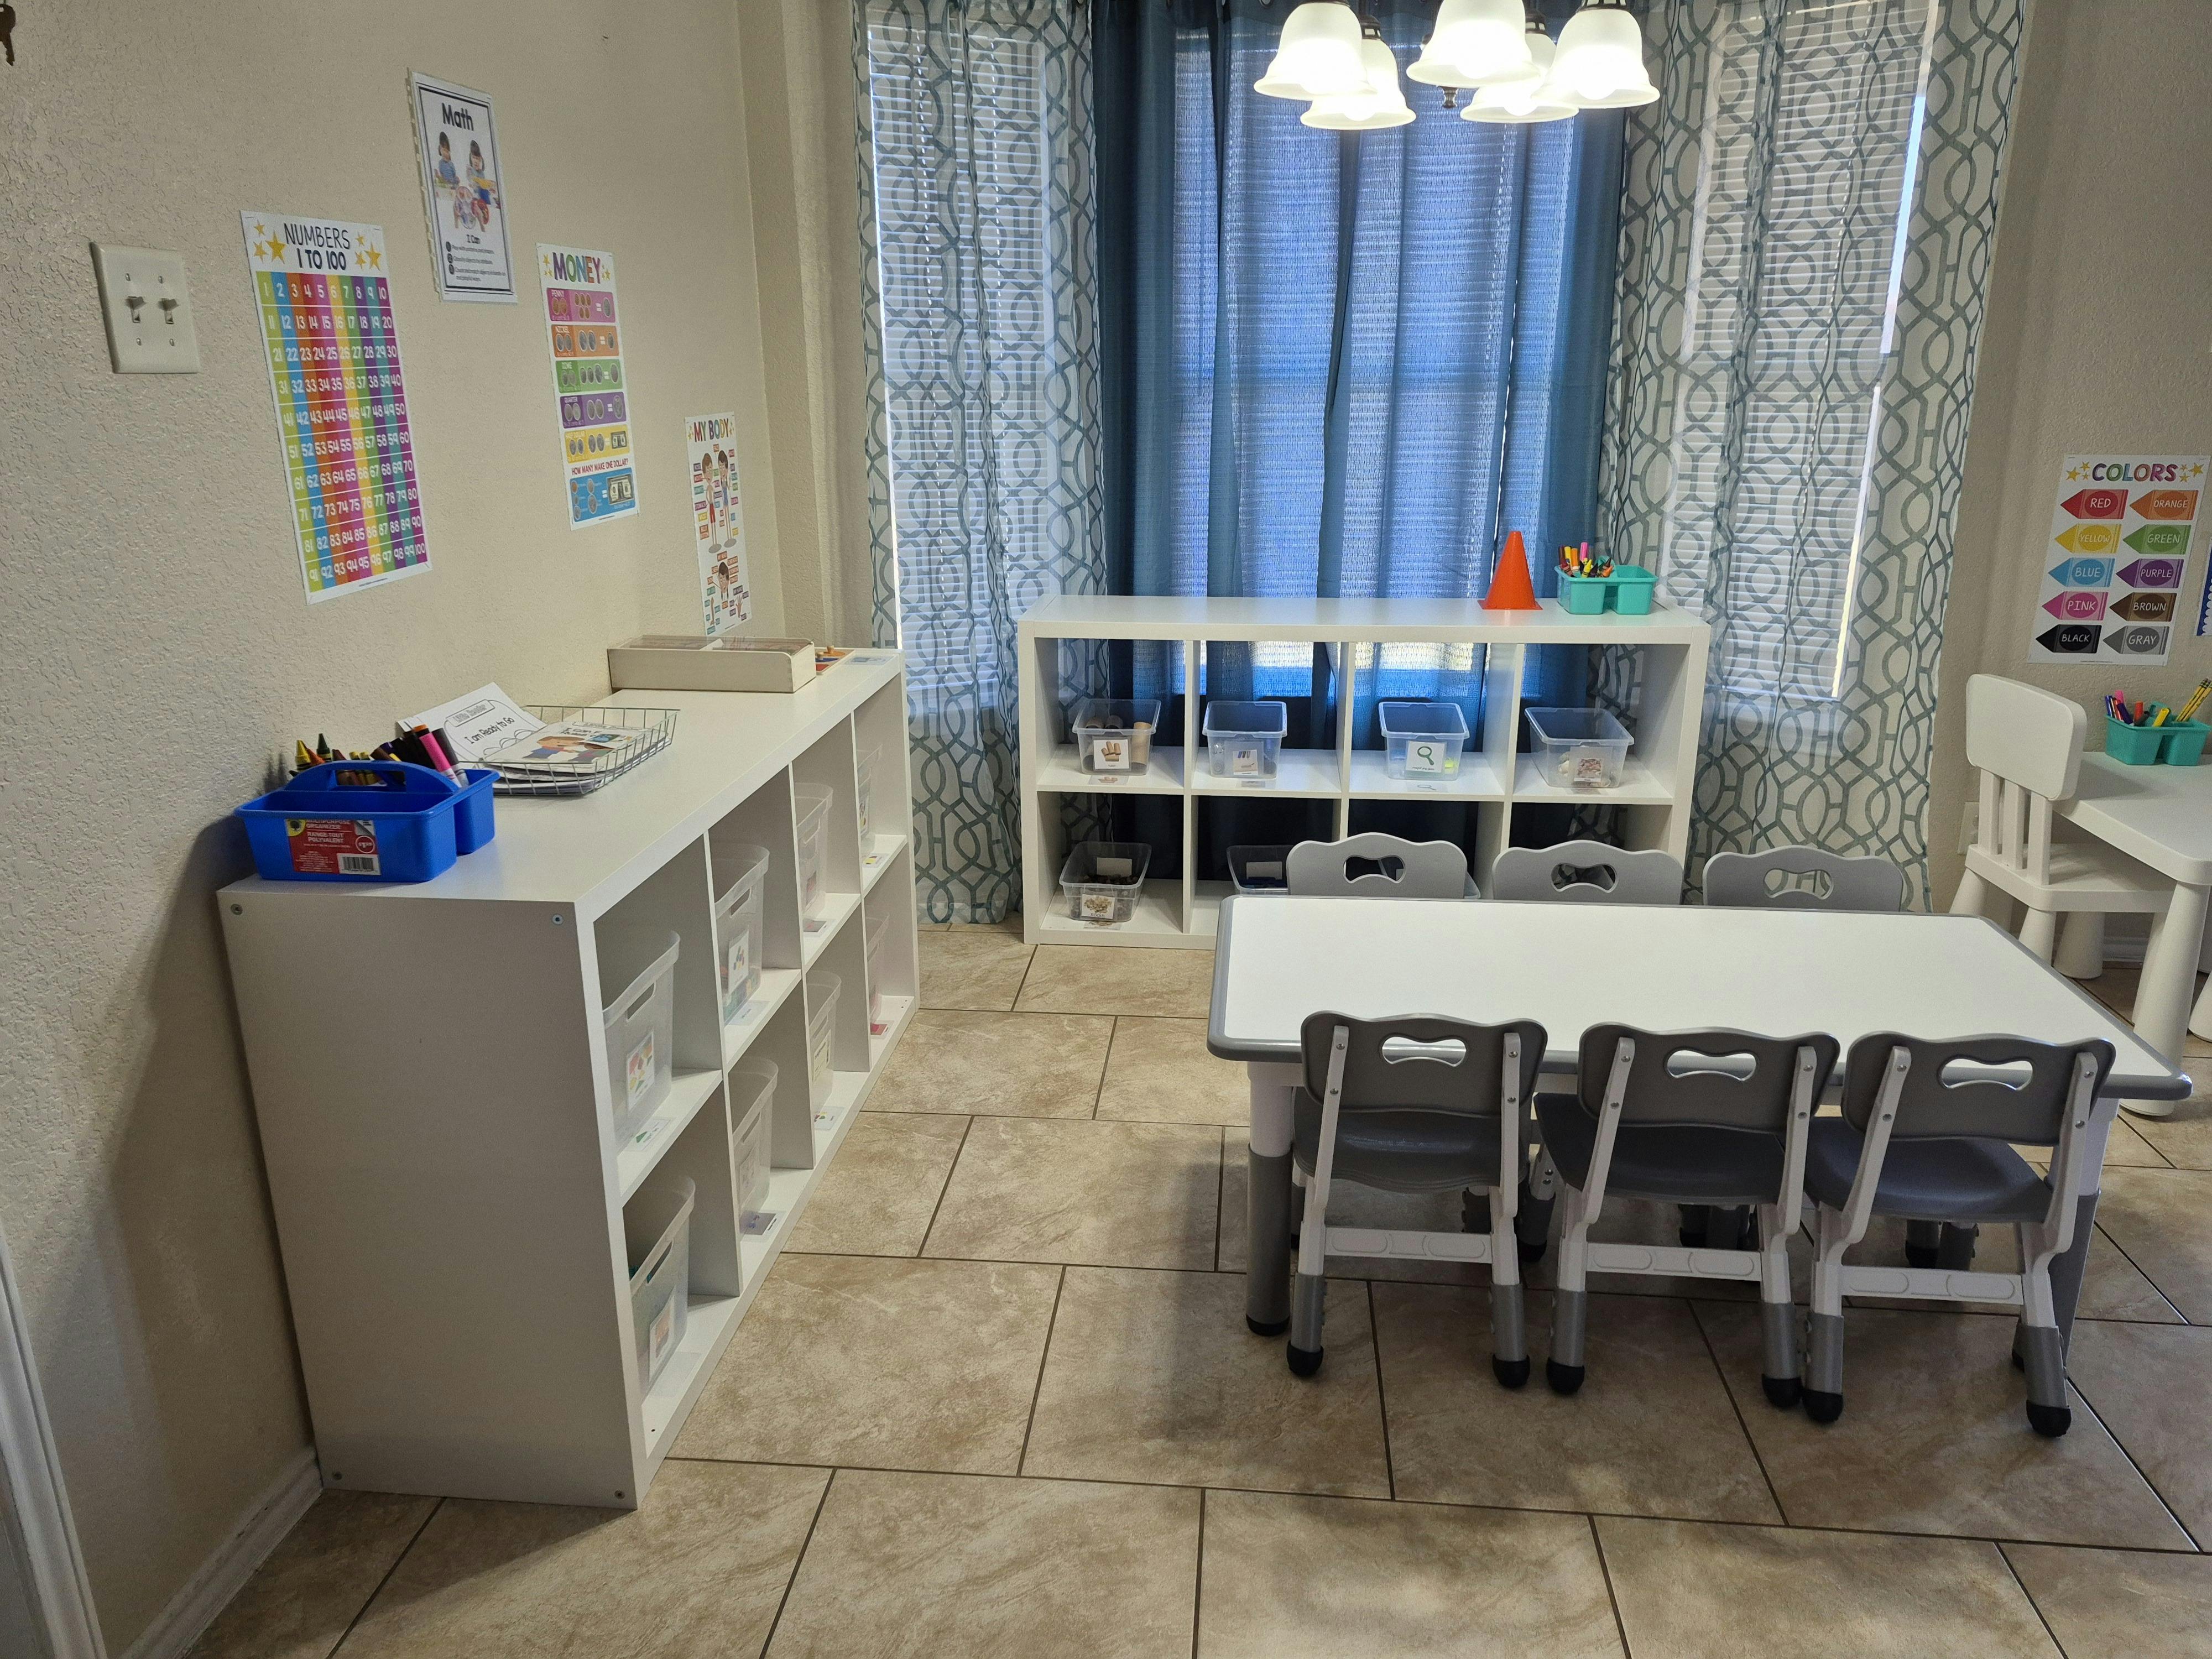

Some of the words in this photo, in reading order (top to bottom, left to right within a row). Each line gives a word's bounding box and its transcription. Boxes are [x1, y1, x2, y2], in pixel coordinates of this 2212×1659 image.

[441, 103, 474, 131] Math
[284, 223, 350, 249] NUMBERS
[466, 234, 471, 243] I
[296, 248, 302, 268] 1
[305, 249, 322, 269] TO
[326, 251, 346, 270] 100
[552, 252, 601, 284] MONEY
[264, 283, 268, 297] 1
[276, 283, 284, 298] 2
[291, 284, 298, 298] 3
[304, 284, 312, 298] 4
[317, 284, 324, 298] 5
[343, 285, 348, 299] 7
[356, 286, 362, 299] 8
[367, 286, 374, 299] 9
[378, 286, 387, 300] 10
[268, 315, 275, 329] 11
[281, 315, 291, 329] 12
[295, 316, 305, 329] 13
[309, 316, 318, 329] 14
[321, 316, 331, 329] 15
[347, 316, 355, 328] 17
[359, 316, 368, 328] 18
[371, 316, 379, 328] 19
[382, 316, 392, 328] 20
[273, 347, 283, 362] 21
[286, 347, 298, 361] 22
[300, 347, 312, 361] 23
[312, 347, 325, 361] 24
[326, 346, 338, 360] 25
[352, 346, 362, 359] 27
[363, 346, 374, 358] 28
[375, 345, 386, 358] 29
[387, 345, 397, 357] 30
[278, 380, 288, 394] 31
[291, 379, 304, 394] 32
[305, 379, 317, 393] 33
[317, 378, 330, 392] 34
[331, 377, 342, 390] 35
[356, 377, 366, 389] 37
[368, 375, 379, 388] 38
[379, 375, 390, 387] 39
[390, 374, 401, 386] 40
[284, 413, 293, 426] 41
[296, 412, 309, 425] 42
[310, 410, 322, 424] 43
[322, 410, 335, 422] 44
[335, 409, 347, 421] 45
[361, 406, 371, 419] 47
[372, 405, 383, 418] 48
[383, 404, 395, 416] 49
[394, 403, 405, 415] 50
[693, 421, 706, 442] MY
[708, 418, 729, 440] BODY
[289, 445, 298, 459] 51
[301, 444, 314, 457] 52
[315, 442, 327, 455] 53
[327, 441, 340, 454] 54
[340, 440, 352, 452] 55
[365, 436, 375, 448] 57
[377, 435, 387, 447] 58
[388, 434, 399, 446] 59
[399, 432, 409, 444] 60
[294, 477, 303, 491] 61
[306, 475, 319, 488] 62
[320, 473, 332, 487] 63
[332, 472, 345, 484] 64
[345, 469, 356, 482] 65
[369, 466, 379, 478] 67
[381, 464, 392, 476] 68
[392, 462, 404, 474] 69
[403, 461, 414, 472] 70
[571, 467, 581, 476] HOW
[582, 464, 594, 473] MANY
[594, 462, 604, 471] MAKE
[613, 458, 628, 467] DOLLAR?
[2092, 463, 2179, 482] COLORS
[299, 508, 308, 521] 71
[311, 506, 325, 519] 72
[324, 504, 337, 517] 73
[337, 502, 349, 514] 74
[349, 499, 361, 512] 75
[374, 495, 384, 507] 77
[385, 493, 395, 504] 78
[396, 491, 408, 502] 79
[407, 488, 417, 500] 80
[2090, 498, 2111, 508] RED
[2154, 500, 2188, 508] ORANGE
[304, 539, 313, 552] 81
[316, 537, 329, 550] 82
[330, 535, 341, 547] 83
[342, 532, 354, 544] 84
[354, 529, 366, 541] 85
[379, 524, 388, 536] 87
[389, 521, 400, 533] 88
[400, 518, 411, 530] 89
[411, 515, 421, 528] 90
[2078, 533, 2111, 542] YELLOW
[2147, 534, 2180, 544] GREEN
[309, 569, 319, 582] 91
[321, 566, 333, 578] 92
[333, 564, 346, 576] 93
[346, 560, 358, 573] 94
[358, 557, 369, 570] 95
[382, 551, 392, 563] 97
[393, 548, 404, 560] 98
[404, 545, 416, 557] 99
[415, 543, 425, 555] 100
[2074, 567, 2101, 577] BLUE
[2141, 568, 2173, 578] PURPLE
[2067, 601, 2096, 611] PINK
[2133, 602, 2167, 611] BROWN
[2062, 634, 2090, 643] BLACK
[2128, 634, 2157, 645] GRAY
[464, 736, 474, 744] I
[471, 733, 484, 742] am
[479, 724, 502, 737] Ready
[503, 717, 515, 727] Go
